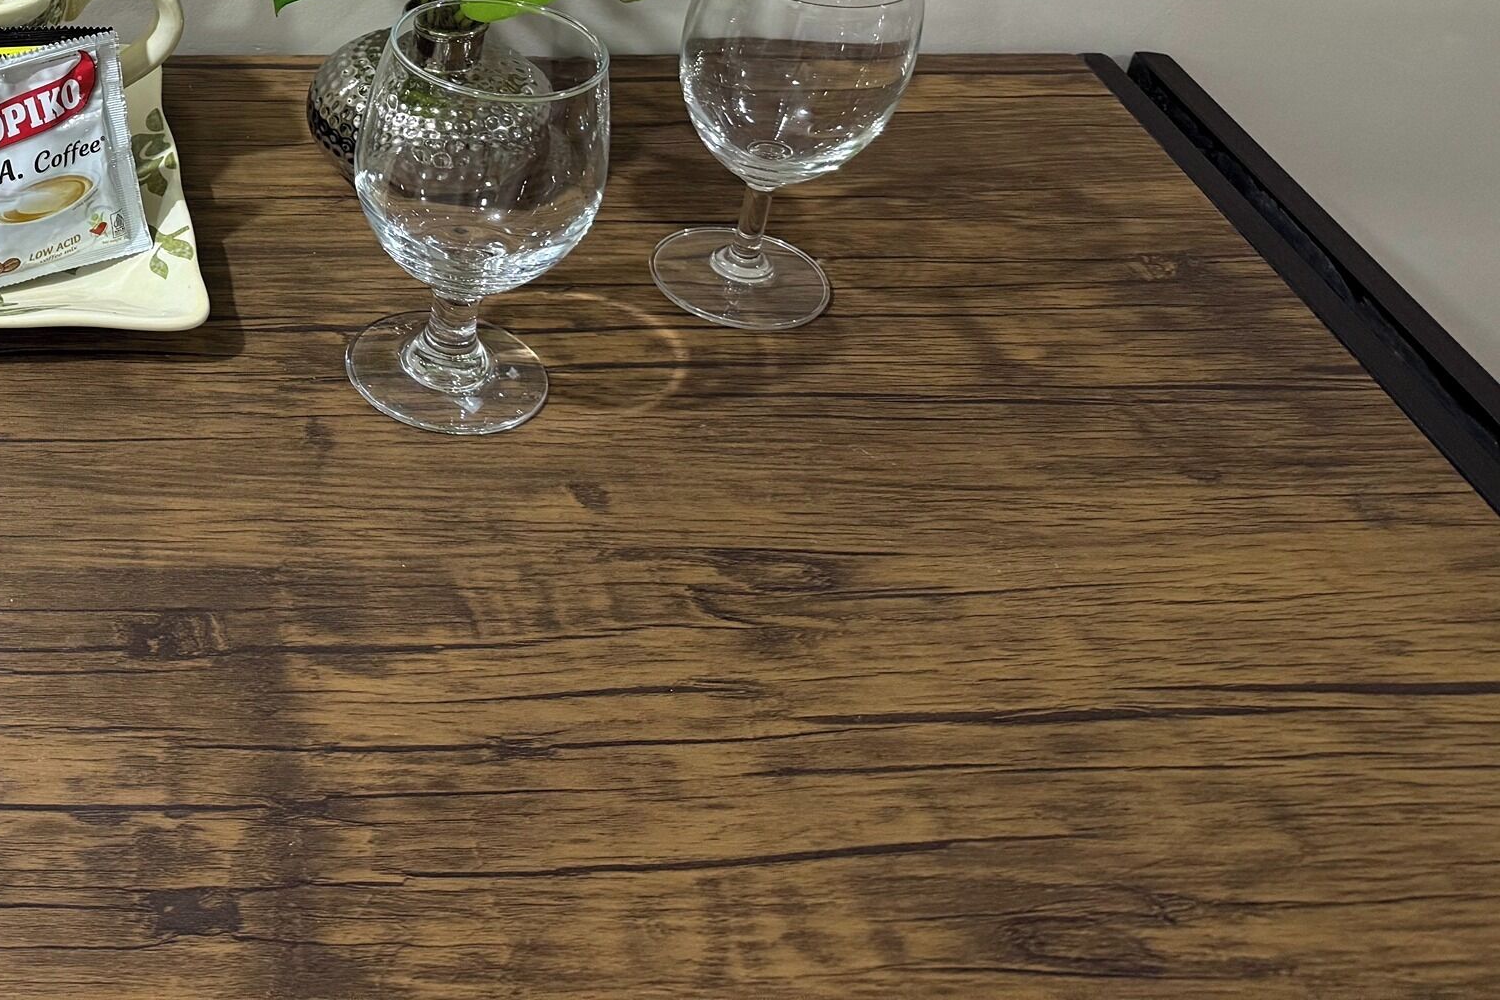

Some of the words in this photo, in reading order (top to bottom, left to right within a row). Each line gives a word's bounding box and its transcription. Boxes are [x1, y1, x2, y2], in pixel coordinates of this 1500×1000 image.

[34, 139, 102, 175] Coffee
[29, 245, 54, 262] LOW
[56, 233, 81, 252] ACID
